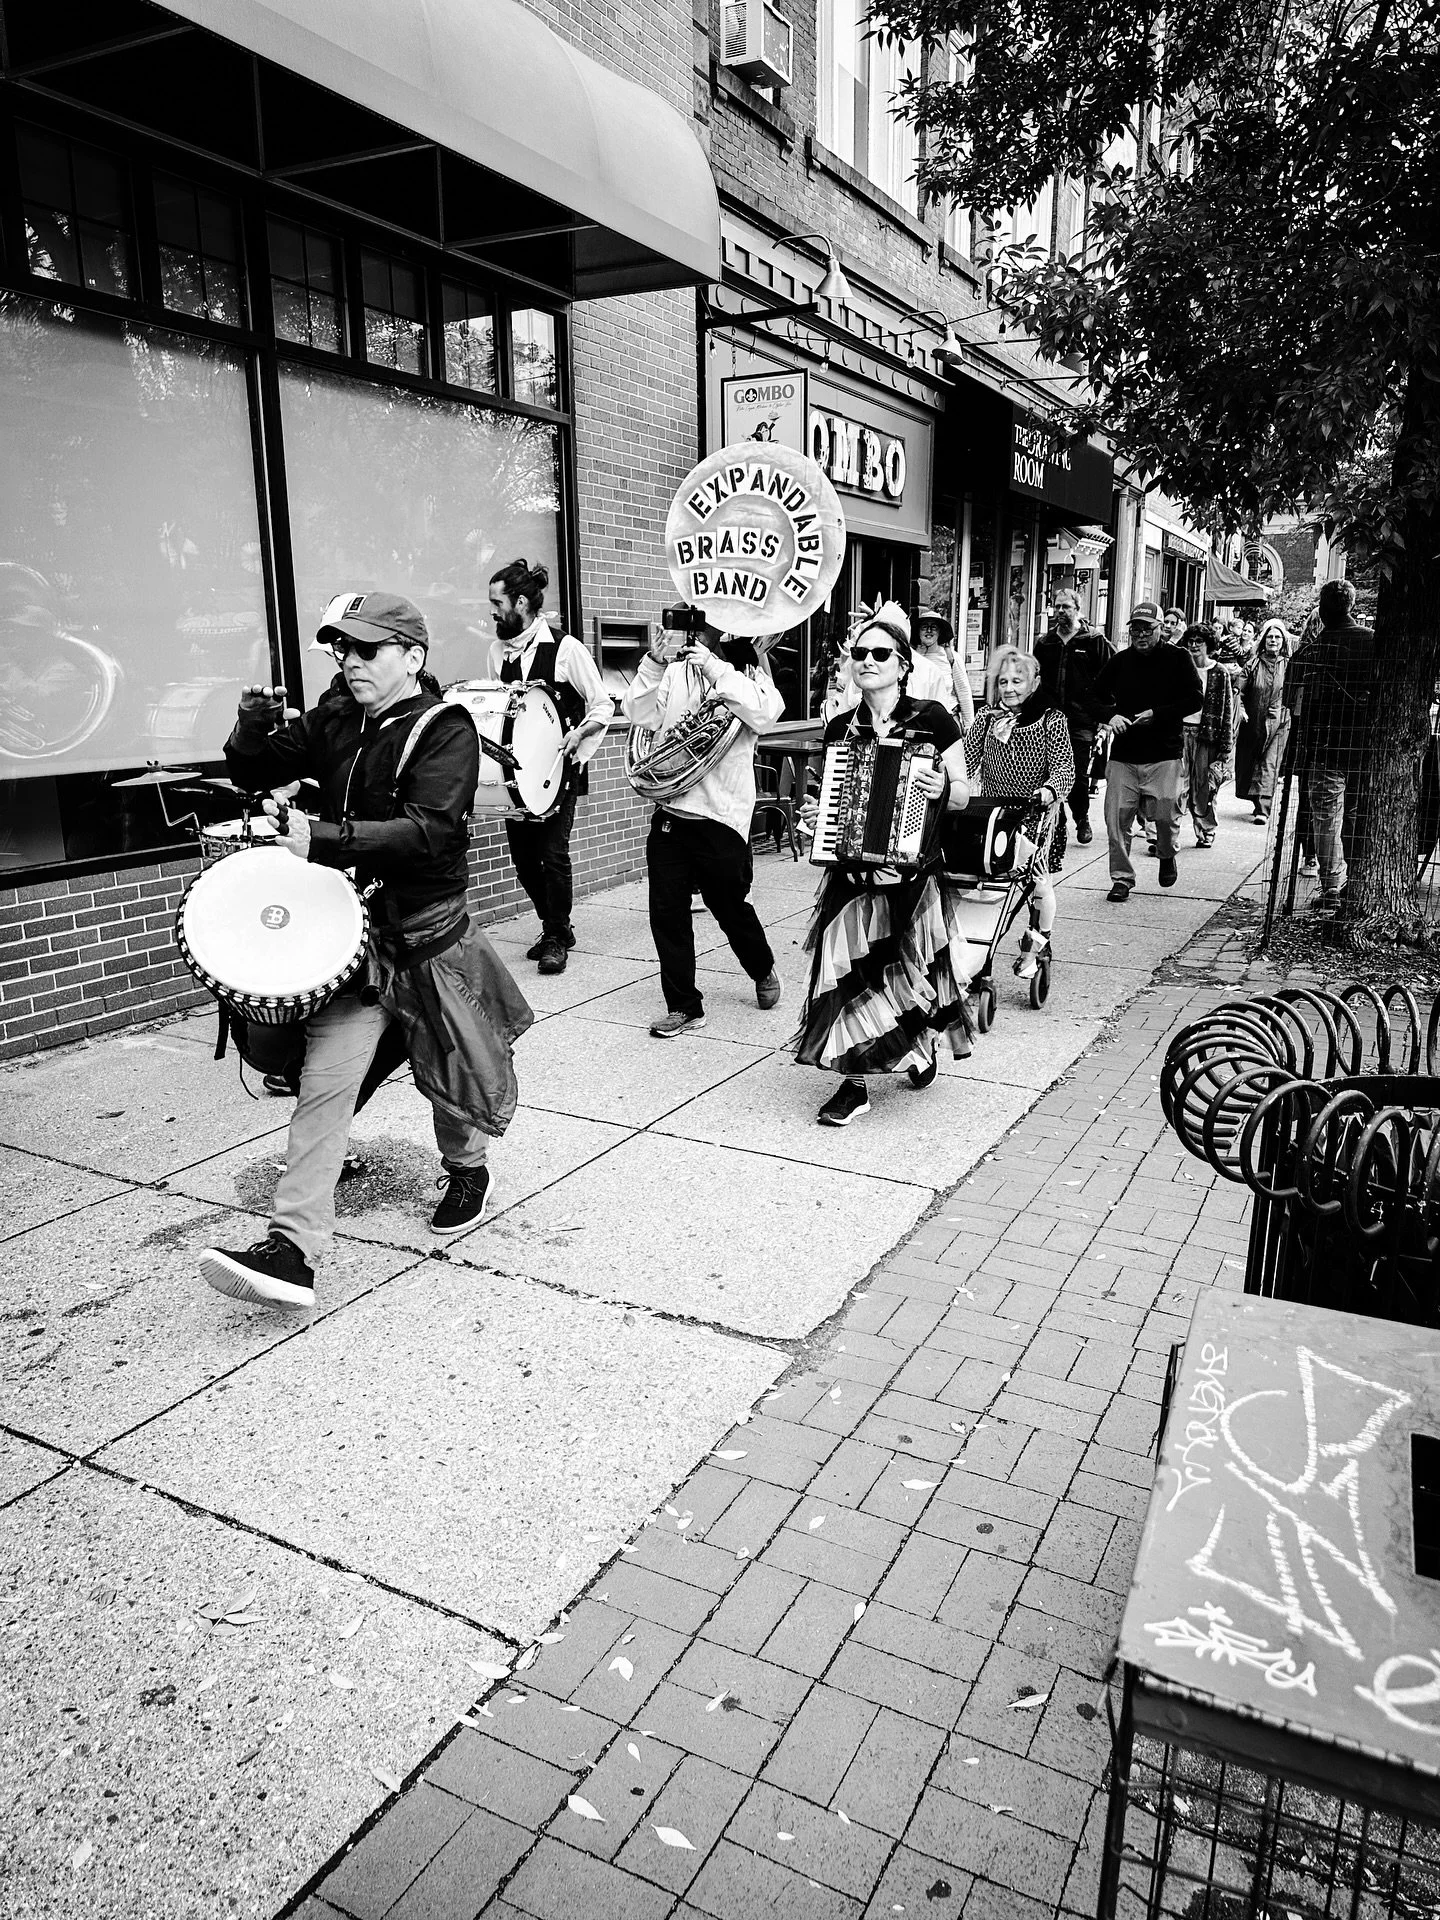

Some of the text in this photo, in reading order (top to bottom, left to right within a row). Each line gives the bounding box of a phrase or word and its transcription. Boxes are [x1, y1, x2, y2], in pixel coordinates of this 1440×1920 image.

[734, 384, 795, 403] GOMBO
[808, 410, 906, 497] OMBO
[1013, 452, 1044, 489] ROOM
[677, 530, 780, 565] BRASS
[688, 467, 820, 599] EXPANDABLE
[693, 571, 767, 602] BAND
